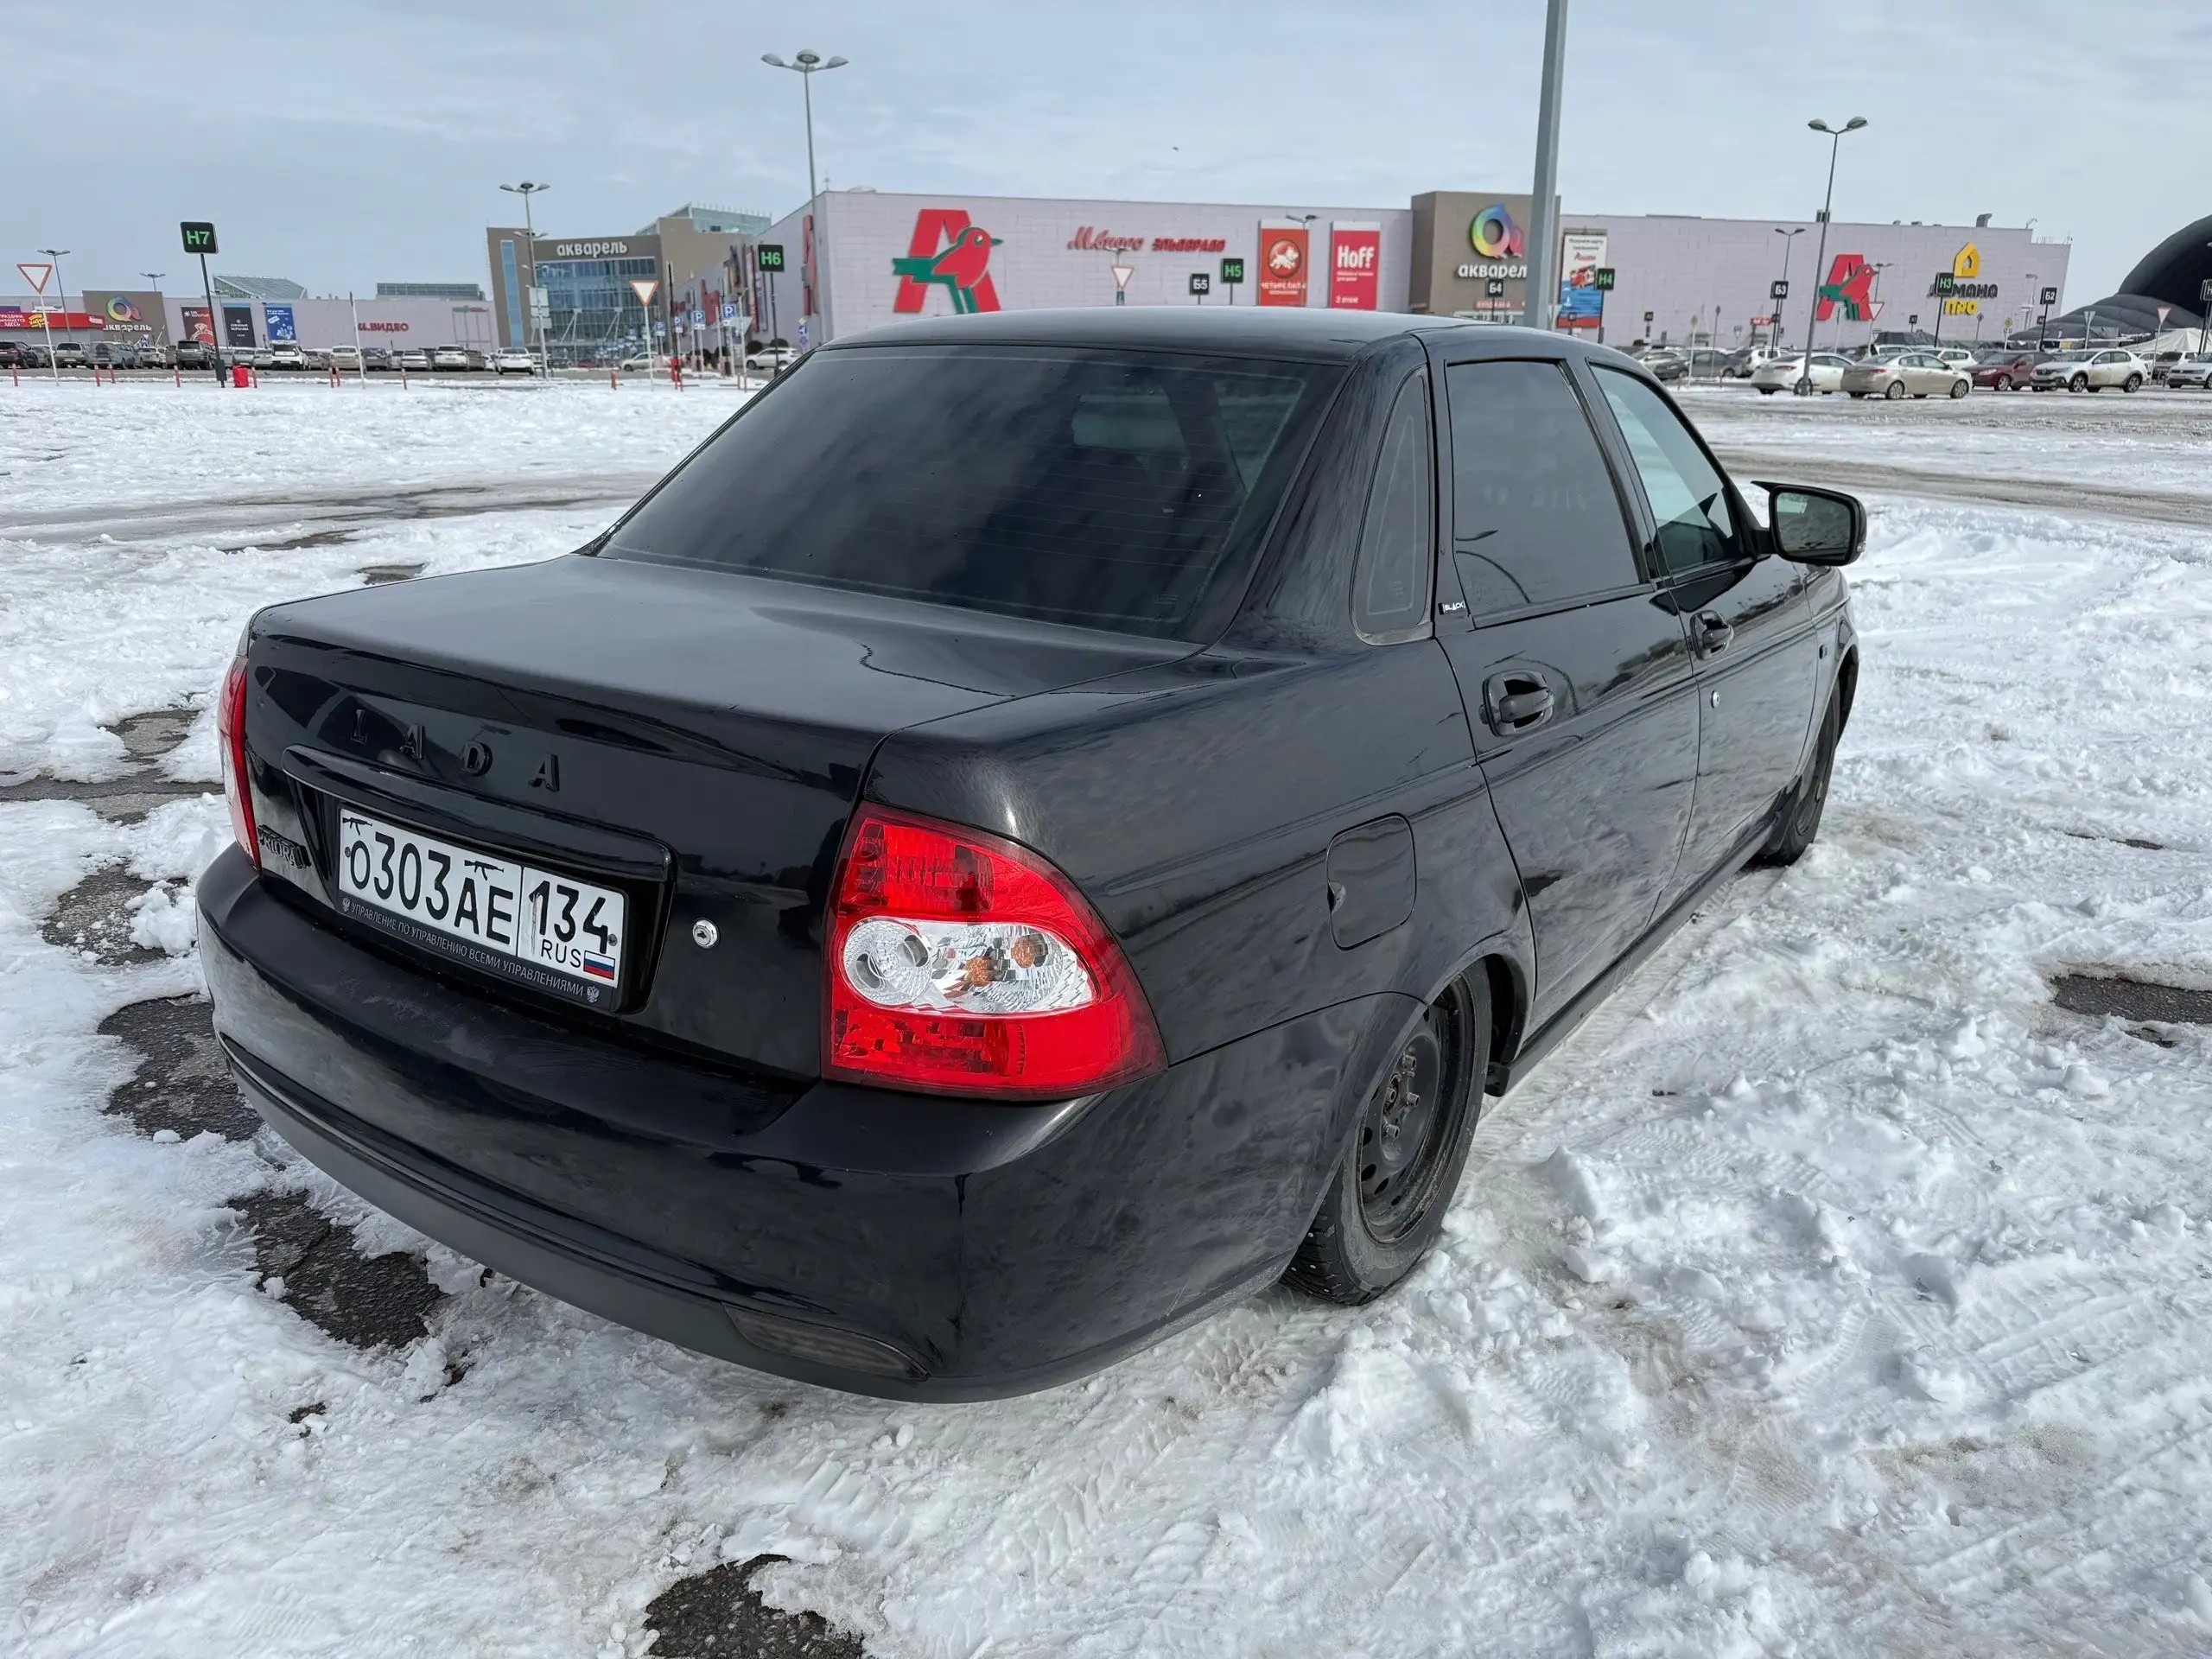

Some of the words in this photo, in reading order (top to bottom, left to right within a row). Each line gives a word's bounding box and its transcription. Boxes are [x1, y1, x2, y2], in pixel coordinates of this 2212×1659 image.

[556, 241, 628, 258] акварель
[1337, 245, 1376, 269] Hoff
[1457, 264, 1528, 279] акварел
[1944, 300, 1979, 315] ПРО
[351, 709, 560, 792] LADA
[529, 880, 608, 954] 134
[352, 902, 397, 931] УПРАВЛЕНИЕ
[398, 921, 410, 935] ПО
[411, 927, 467, 957] УПРАВЛЕНИЮ
[468, 949, 500, 969] ВСЕМИ
[503, 960, 584, 997] УПРАВЛЕНИЯМИ
[541, 939, 582, 968] RUS
